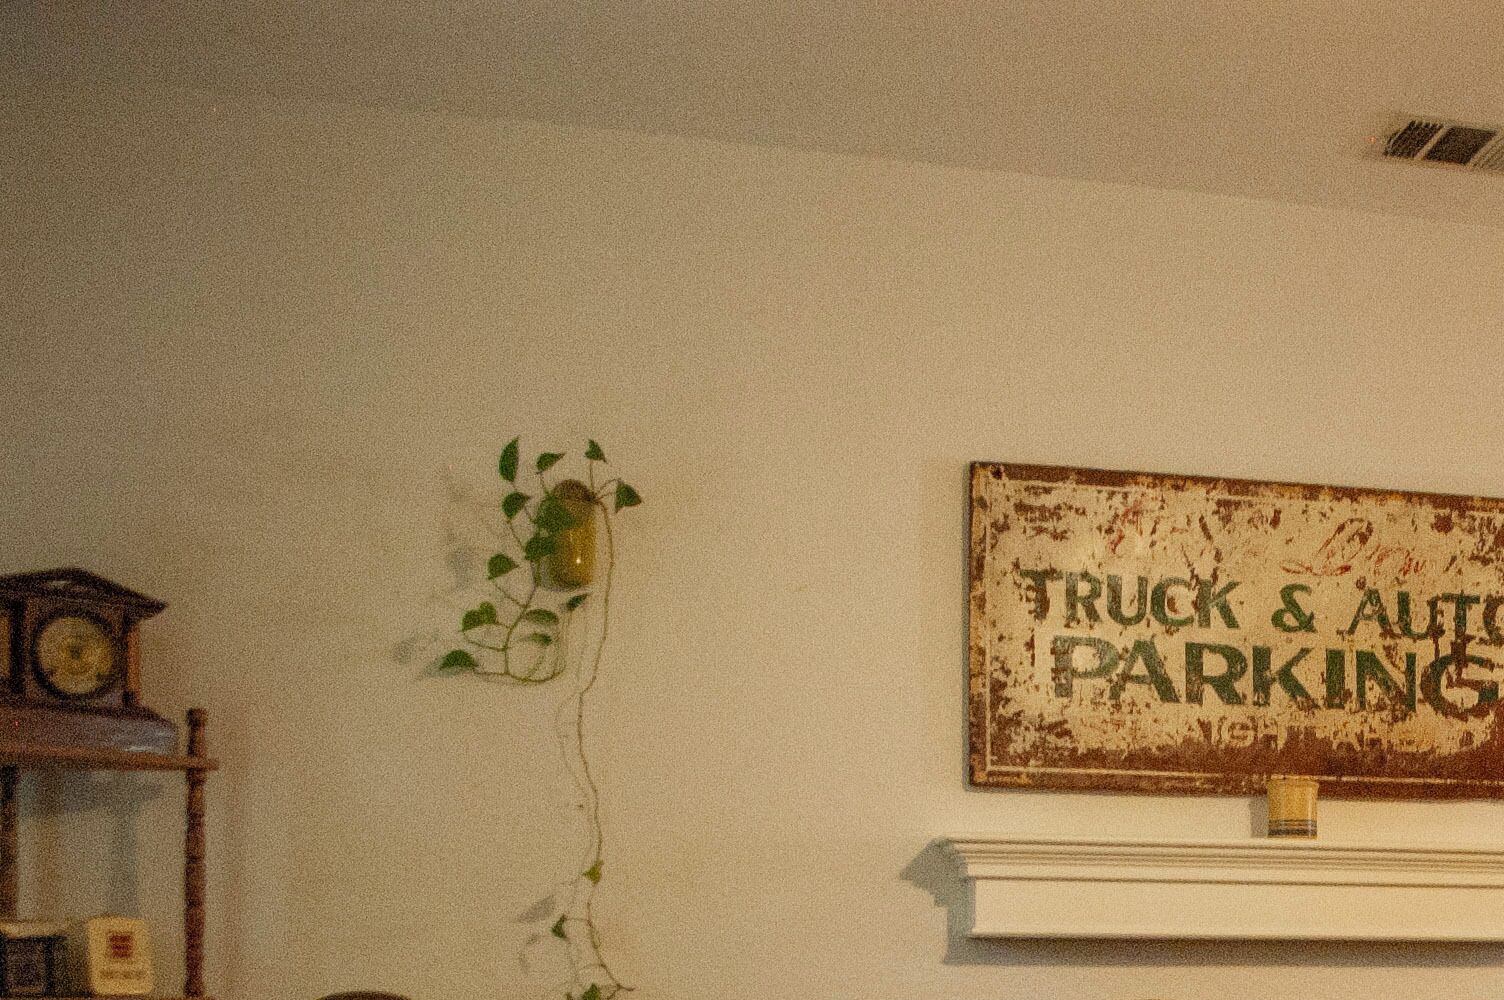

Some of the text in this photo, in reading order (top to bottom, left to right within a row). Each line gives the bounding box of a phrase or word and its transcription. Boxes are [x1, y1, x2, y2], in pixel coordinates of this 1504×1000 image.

[1020, 568, 1240, 629] TRUCK
[1271, 583, 1318, 633] &
[1051, 634, 1501, 719] PARKING
